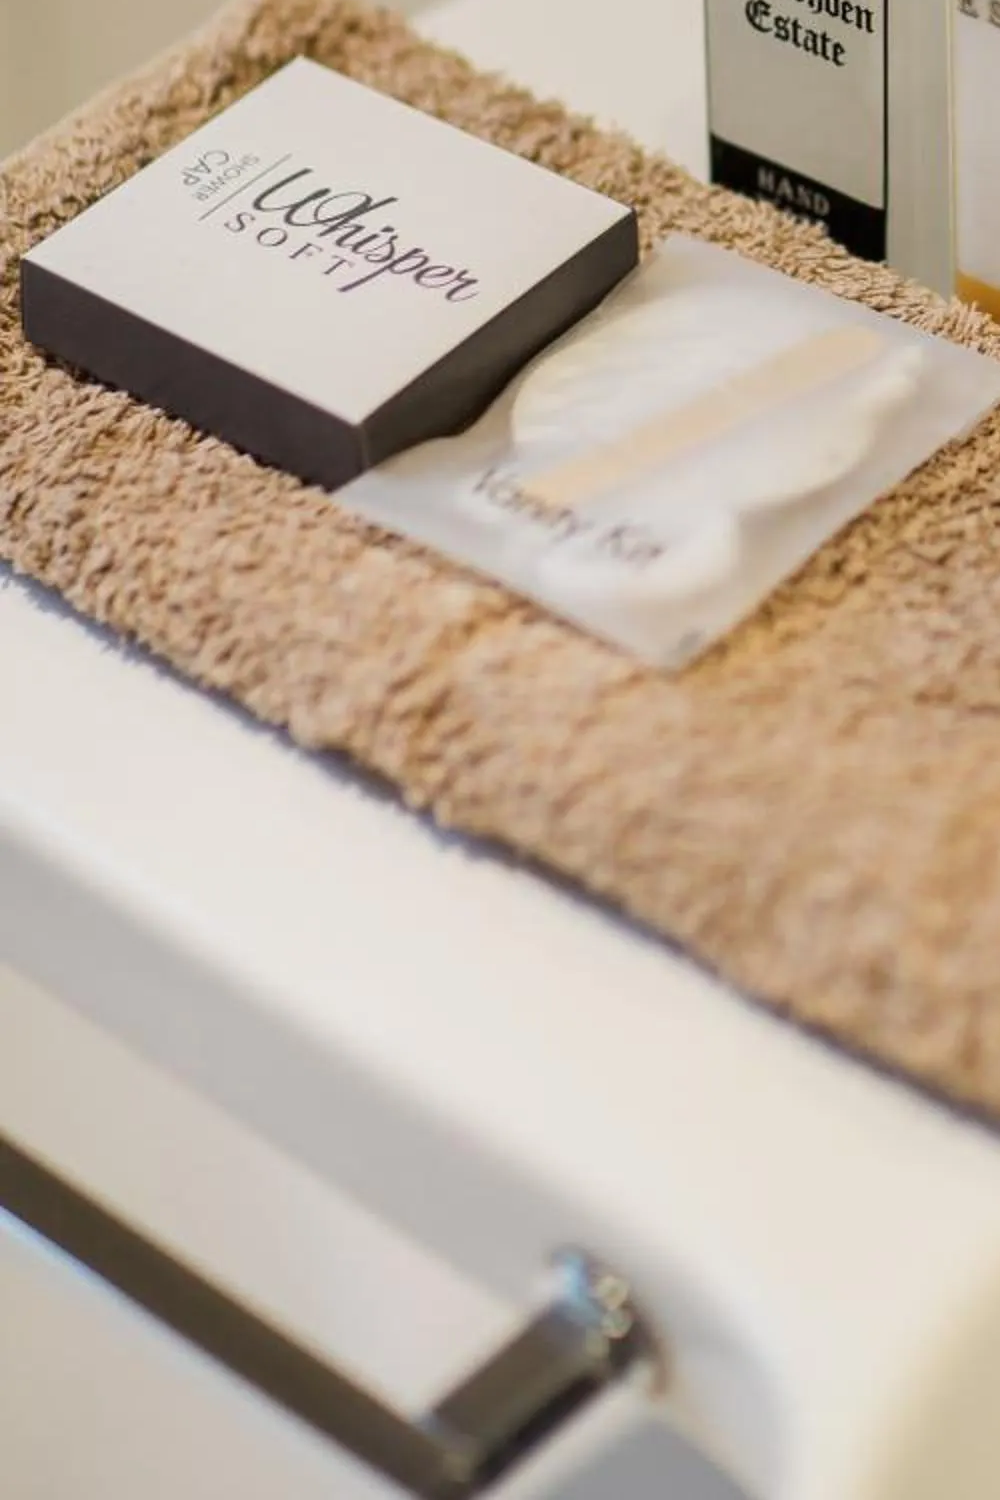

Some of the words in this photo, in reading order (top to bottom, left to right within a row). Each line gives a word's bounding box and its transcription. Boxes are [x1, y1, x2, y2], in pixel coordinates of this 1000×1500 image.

[181, 149, 230, 187] CAP
[757, 167, 830, 217] HAND
[223, 211, 356, 276] SOFT
[252, 167, 479, 302] Whisper
